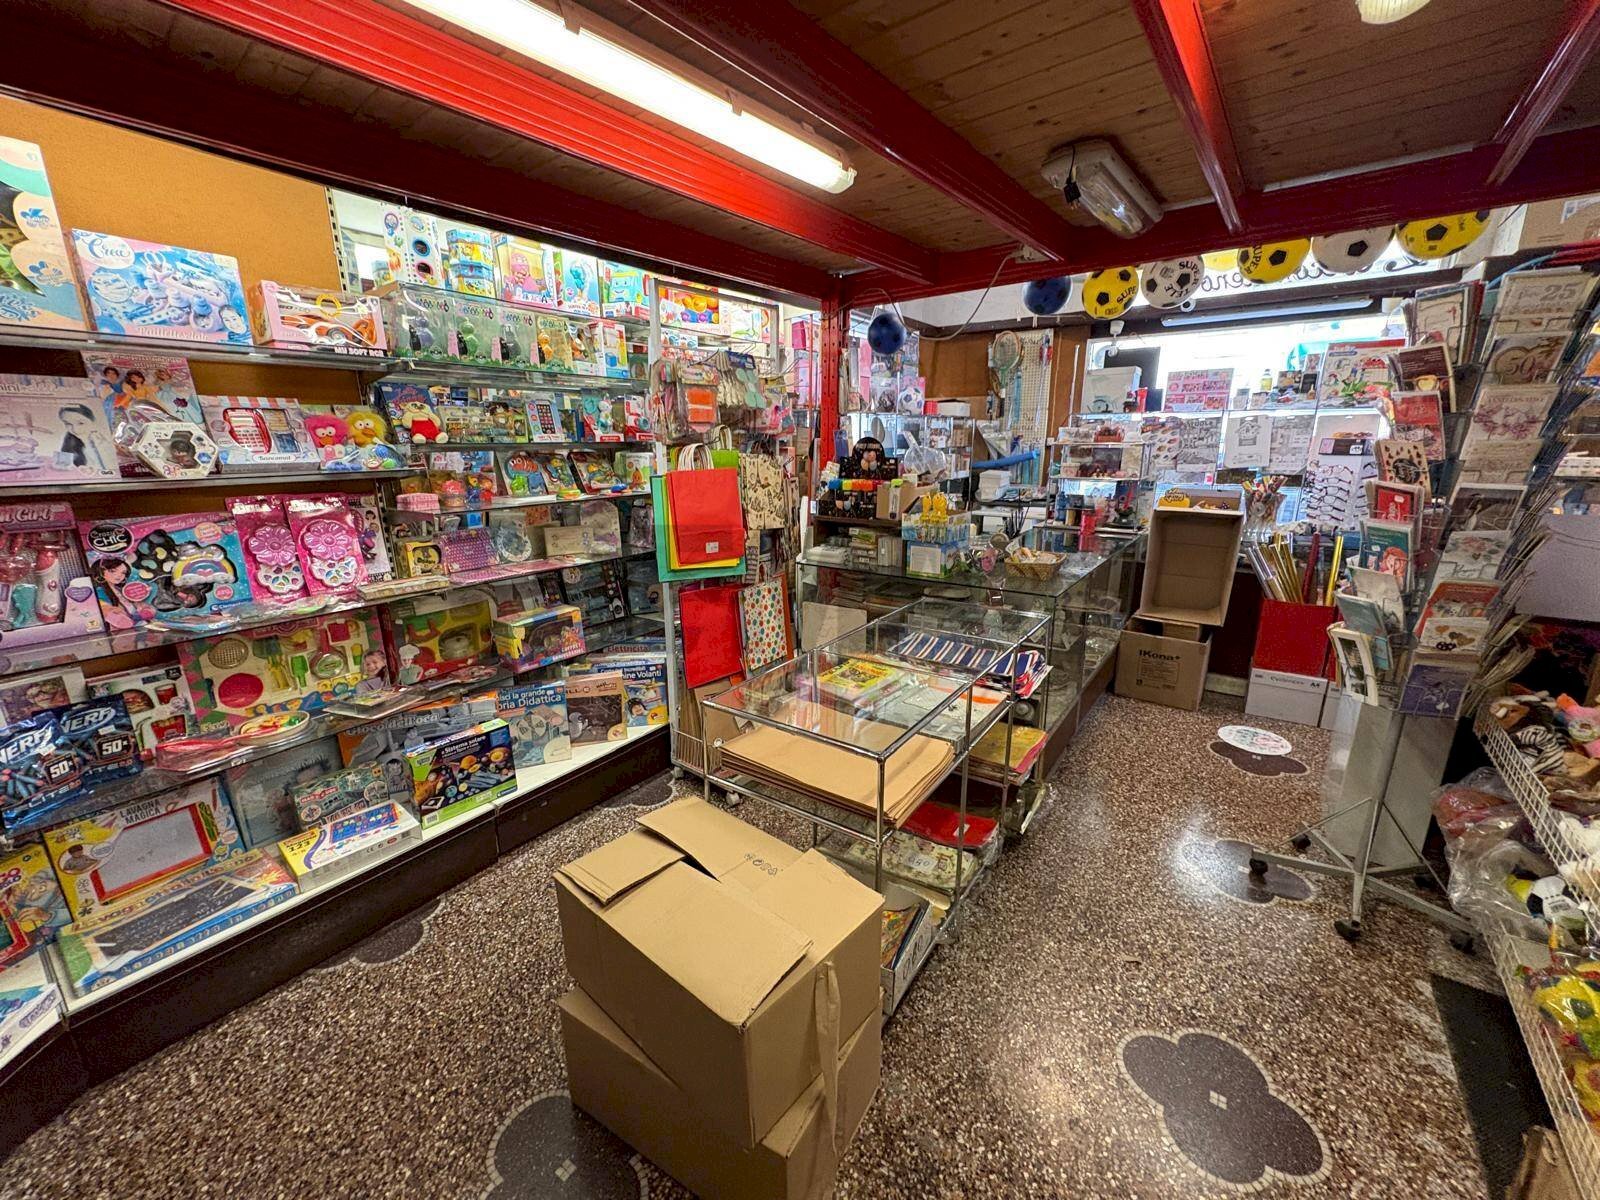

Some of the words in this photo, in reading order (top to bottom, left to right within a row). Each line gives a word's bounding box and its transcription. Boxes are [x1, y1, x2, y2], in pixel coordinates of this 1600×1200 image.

[93, 534, 128, 547] CHIC
[637, 670, 662, 679] Volanti
[512, 690, 520, 699] la
[520, 689, 546, 699] grande
[518, 694, 562, 707] Didattica
[119, 800, 161, 818] LAVAGNA
[125, 806, 162, 825] MAGICA
